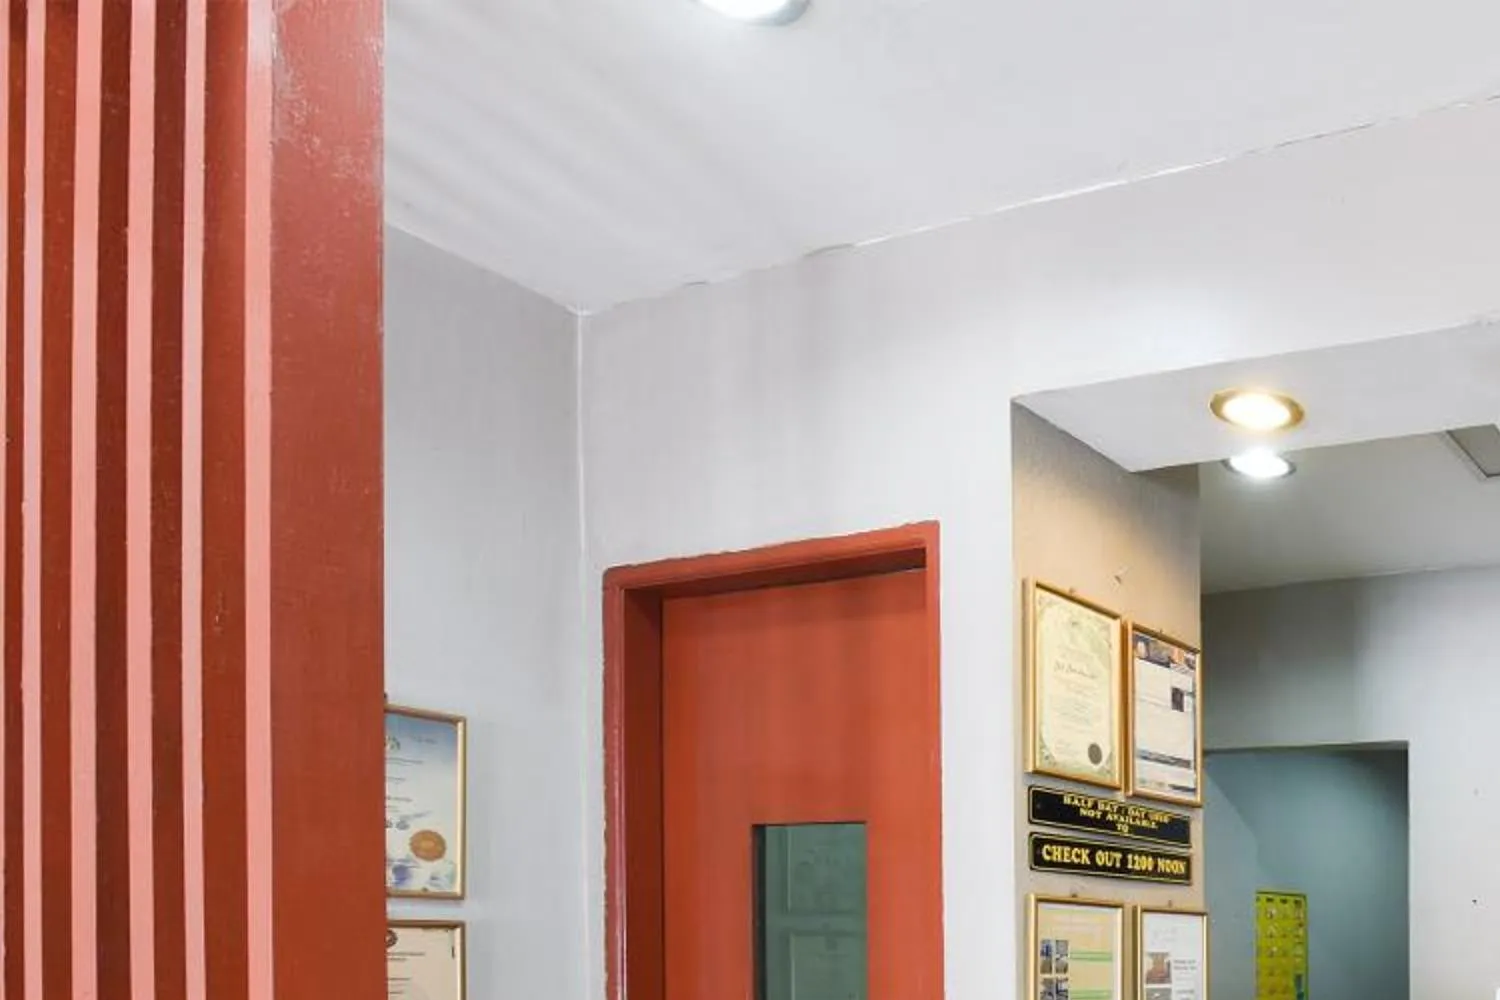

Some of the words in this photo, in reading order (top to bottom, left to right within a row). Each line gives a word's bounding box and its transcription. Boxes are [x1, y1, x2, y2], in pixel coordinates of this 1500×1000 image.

[1063, 794, 1095, 809] HALF
[1079, 807, 1102, 819] NOT
[1106, 812, 1158, 829] AVAILABLE
[1041, 844, 1091, 866] CHECK
[1095, 849, 1122, 868] OUT
[1127, 853, 1153, 871] 1200
[1157, 857, 1187, 875] NOON
